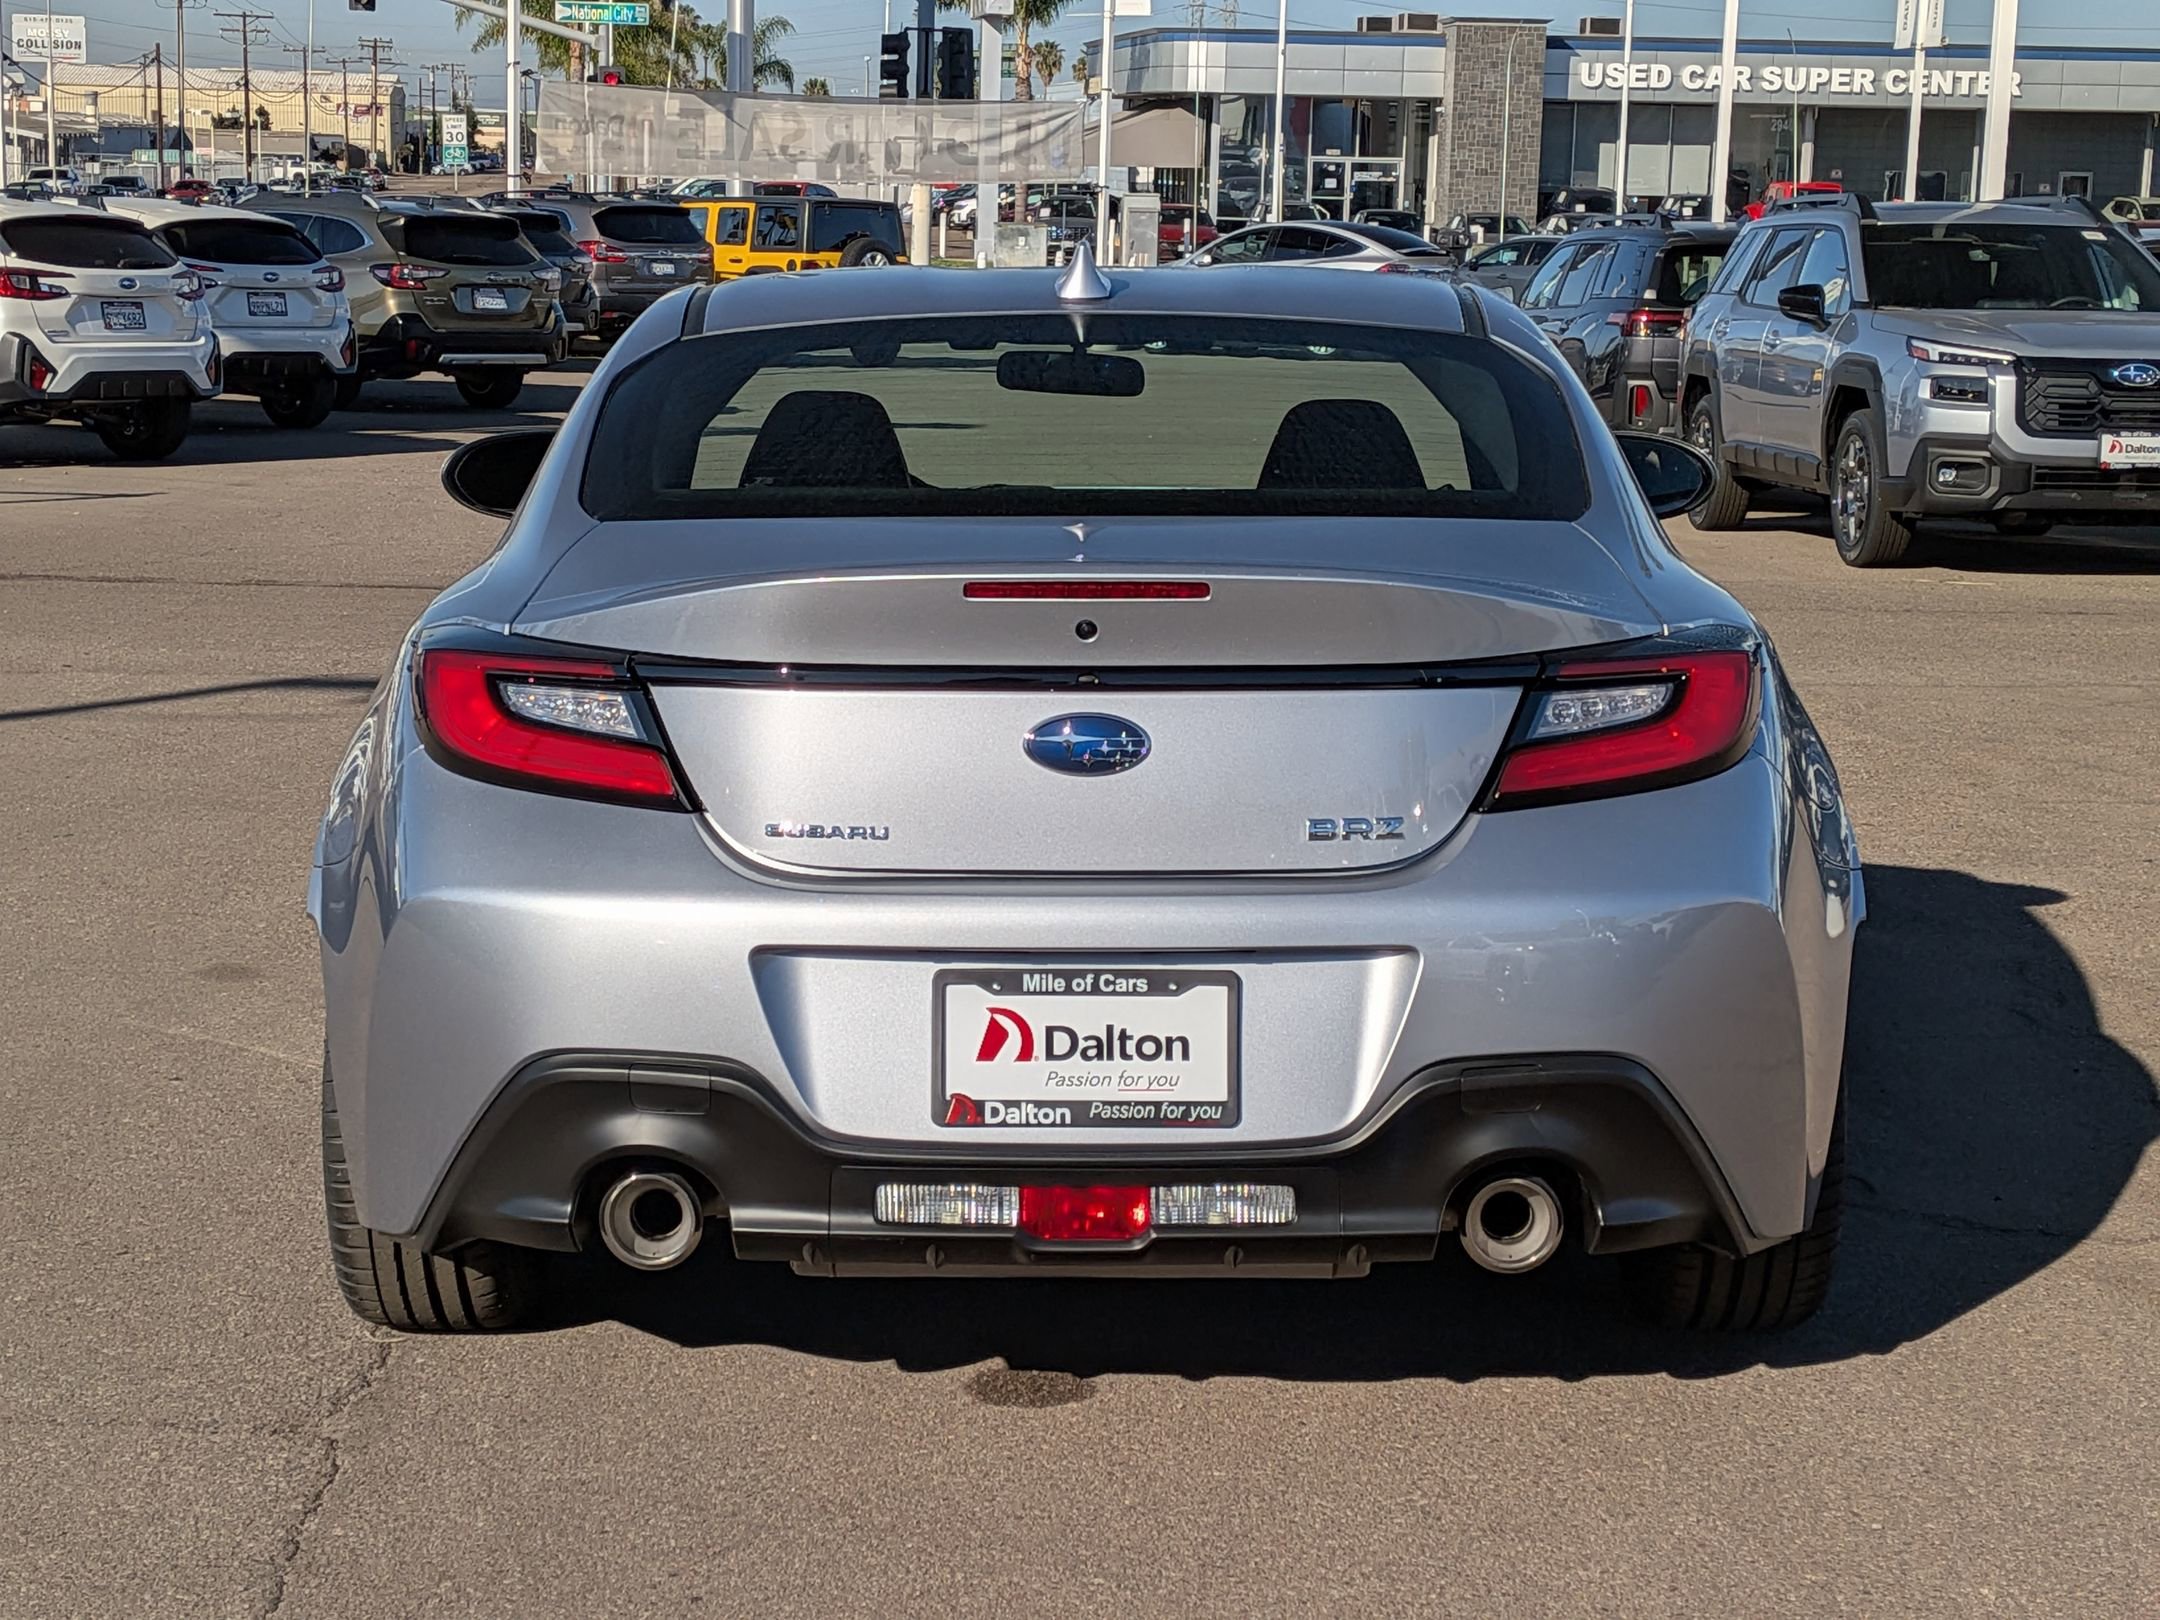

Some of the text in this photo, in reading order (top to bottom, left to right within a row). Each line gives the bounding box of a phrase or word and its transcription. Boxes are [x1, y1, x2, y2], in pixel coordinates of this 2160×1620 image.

[572, 5, 612, 20] National
[613, 5, 633, 22] City
[17, 38, 82, 50] COLLSION
[1580, 62, 1672, 89] USED
[1682, 64, 1753, 91] CAR
[1761, 66, 1876, 95] SUPER
[446, 131, 465, 142] 30
[2125, 443, 2160, 453] Dalton
[764, 823, 889, 840] SUBARU
[1305, 816, 1405, 841] BRZ
[1022, 973, 1149, 993] Mile of Cars
[1044, 1024, 1191, 1062] Dalton
[1045, 1069, 1180, 1090] Passion for you
[984, 1101, 1223, 1125] Dalton Passion for you
